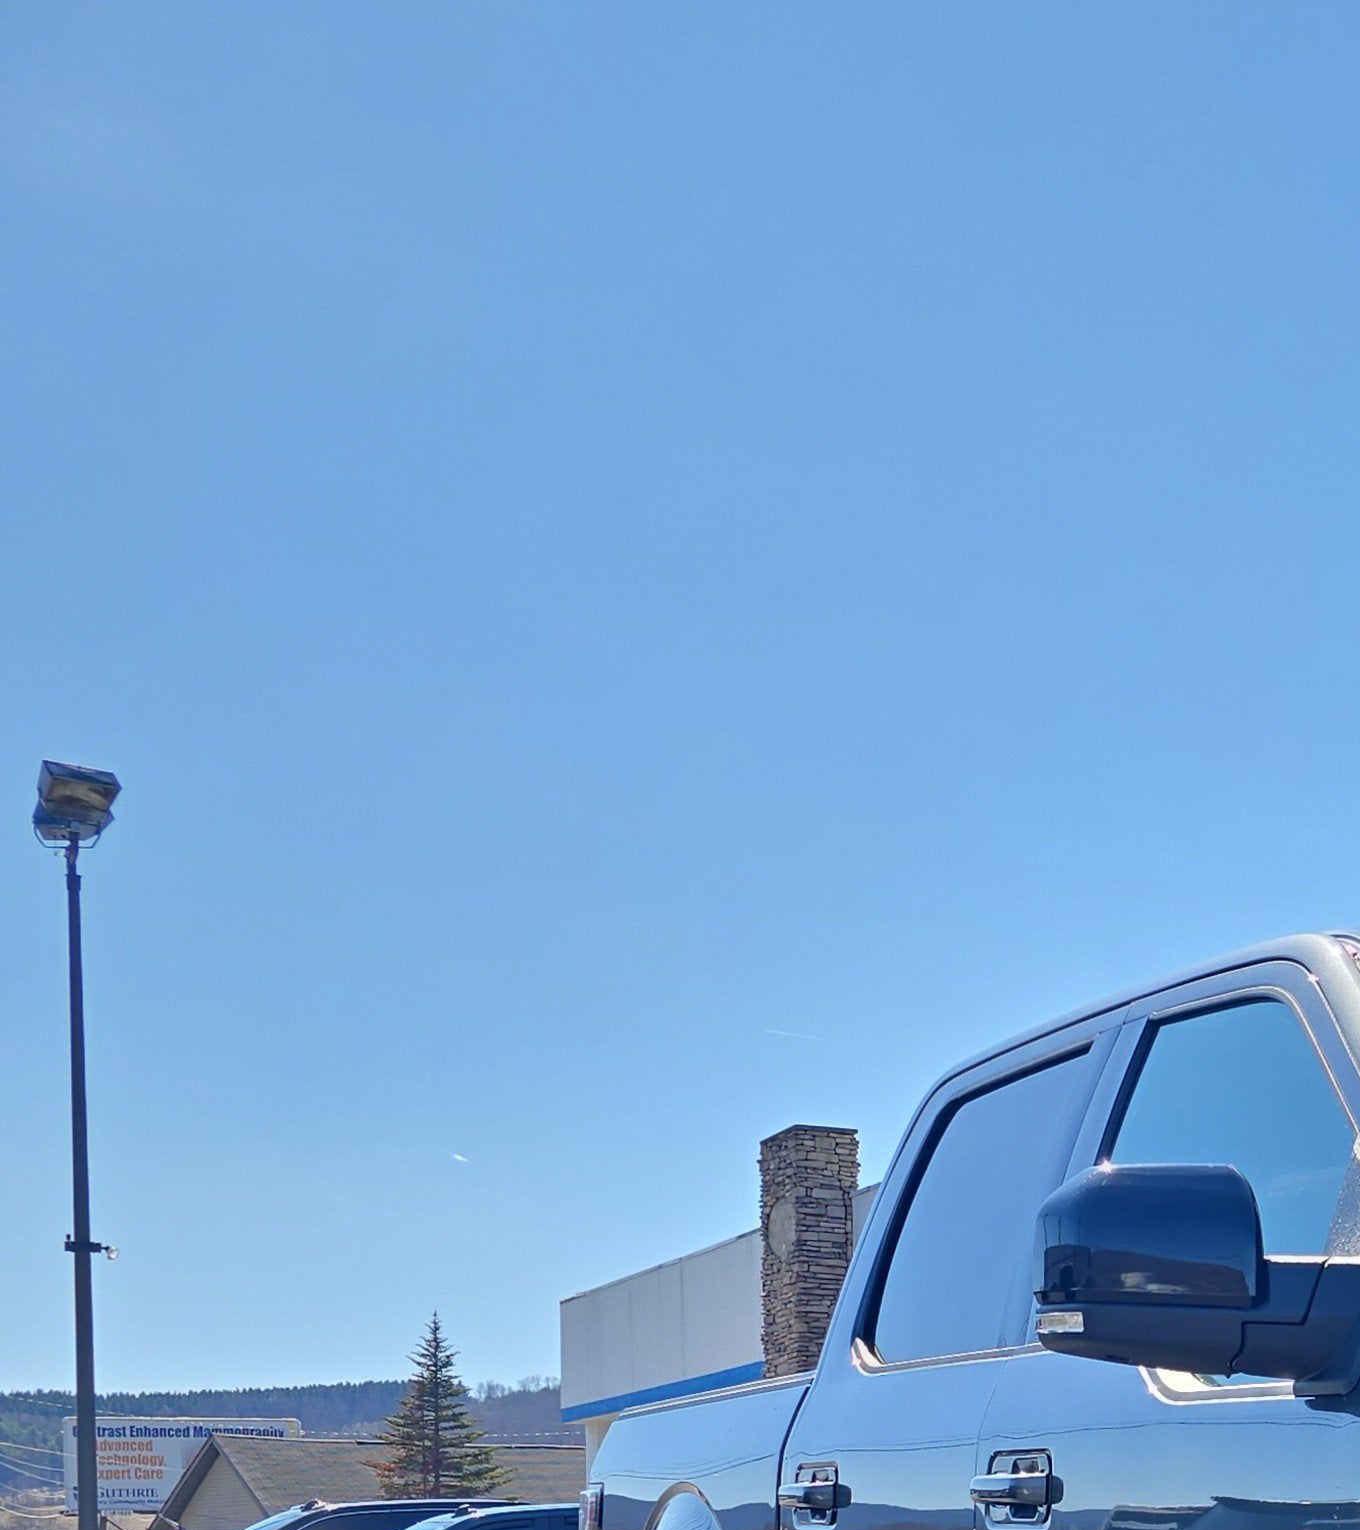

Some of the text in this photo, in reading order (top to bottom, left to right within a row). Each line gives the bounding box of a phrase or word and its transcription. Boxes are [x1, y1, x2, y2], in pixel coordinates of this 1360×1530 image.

[129, 1426, 189, 1438] Enhanced
[97, 1453, 167, 1467] echnology,
[97, 1467, 163, 1480] xpert Care
